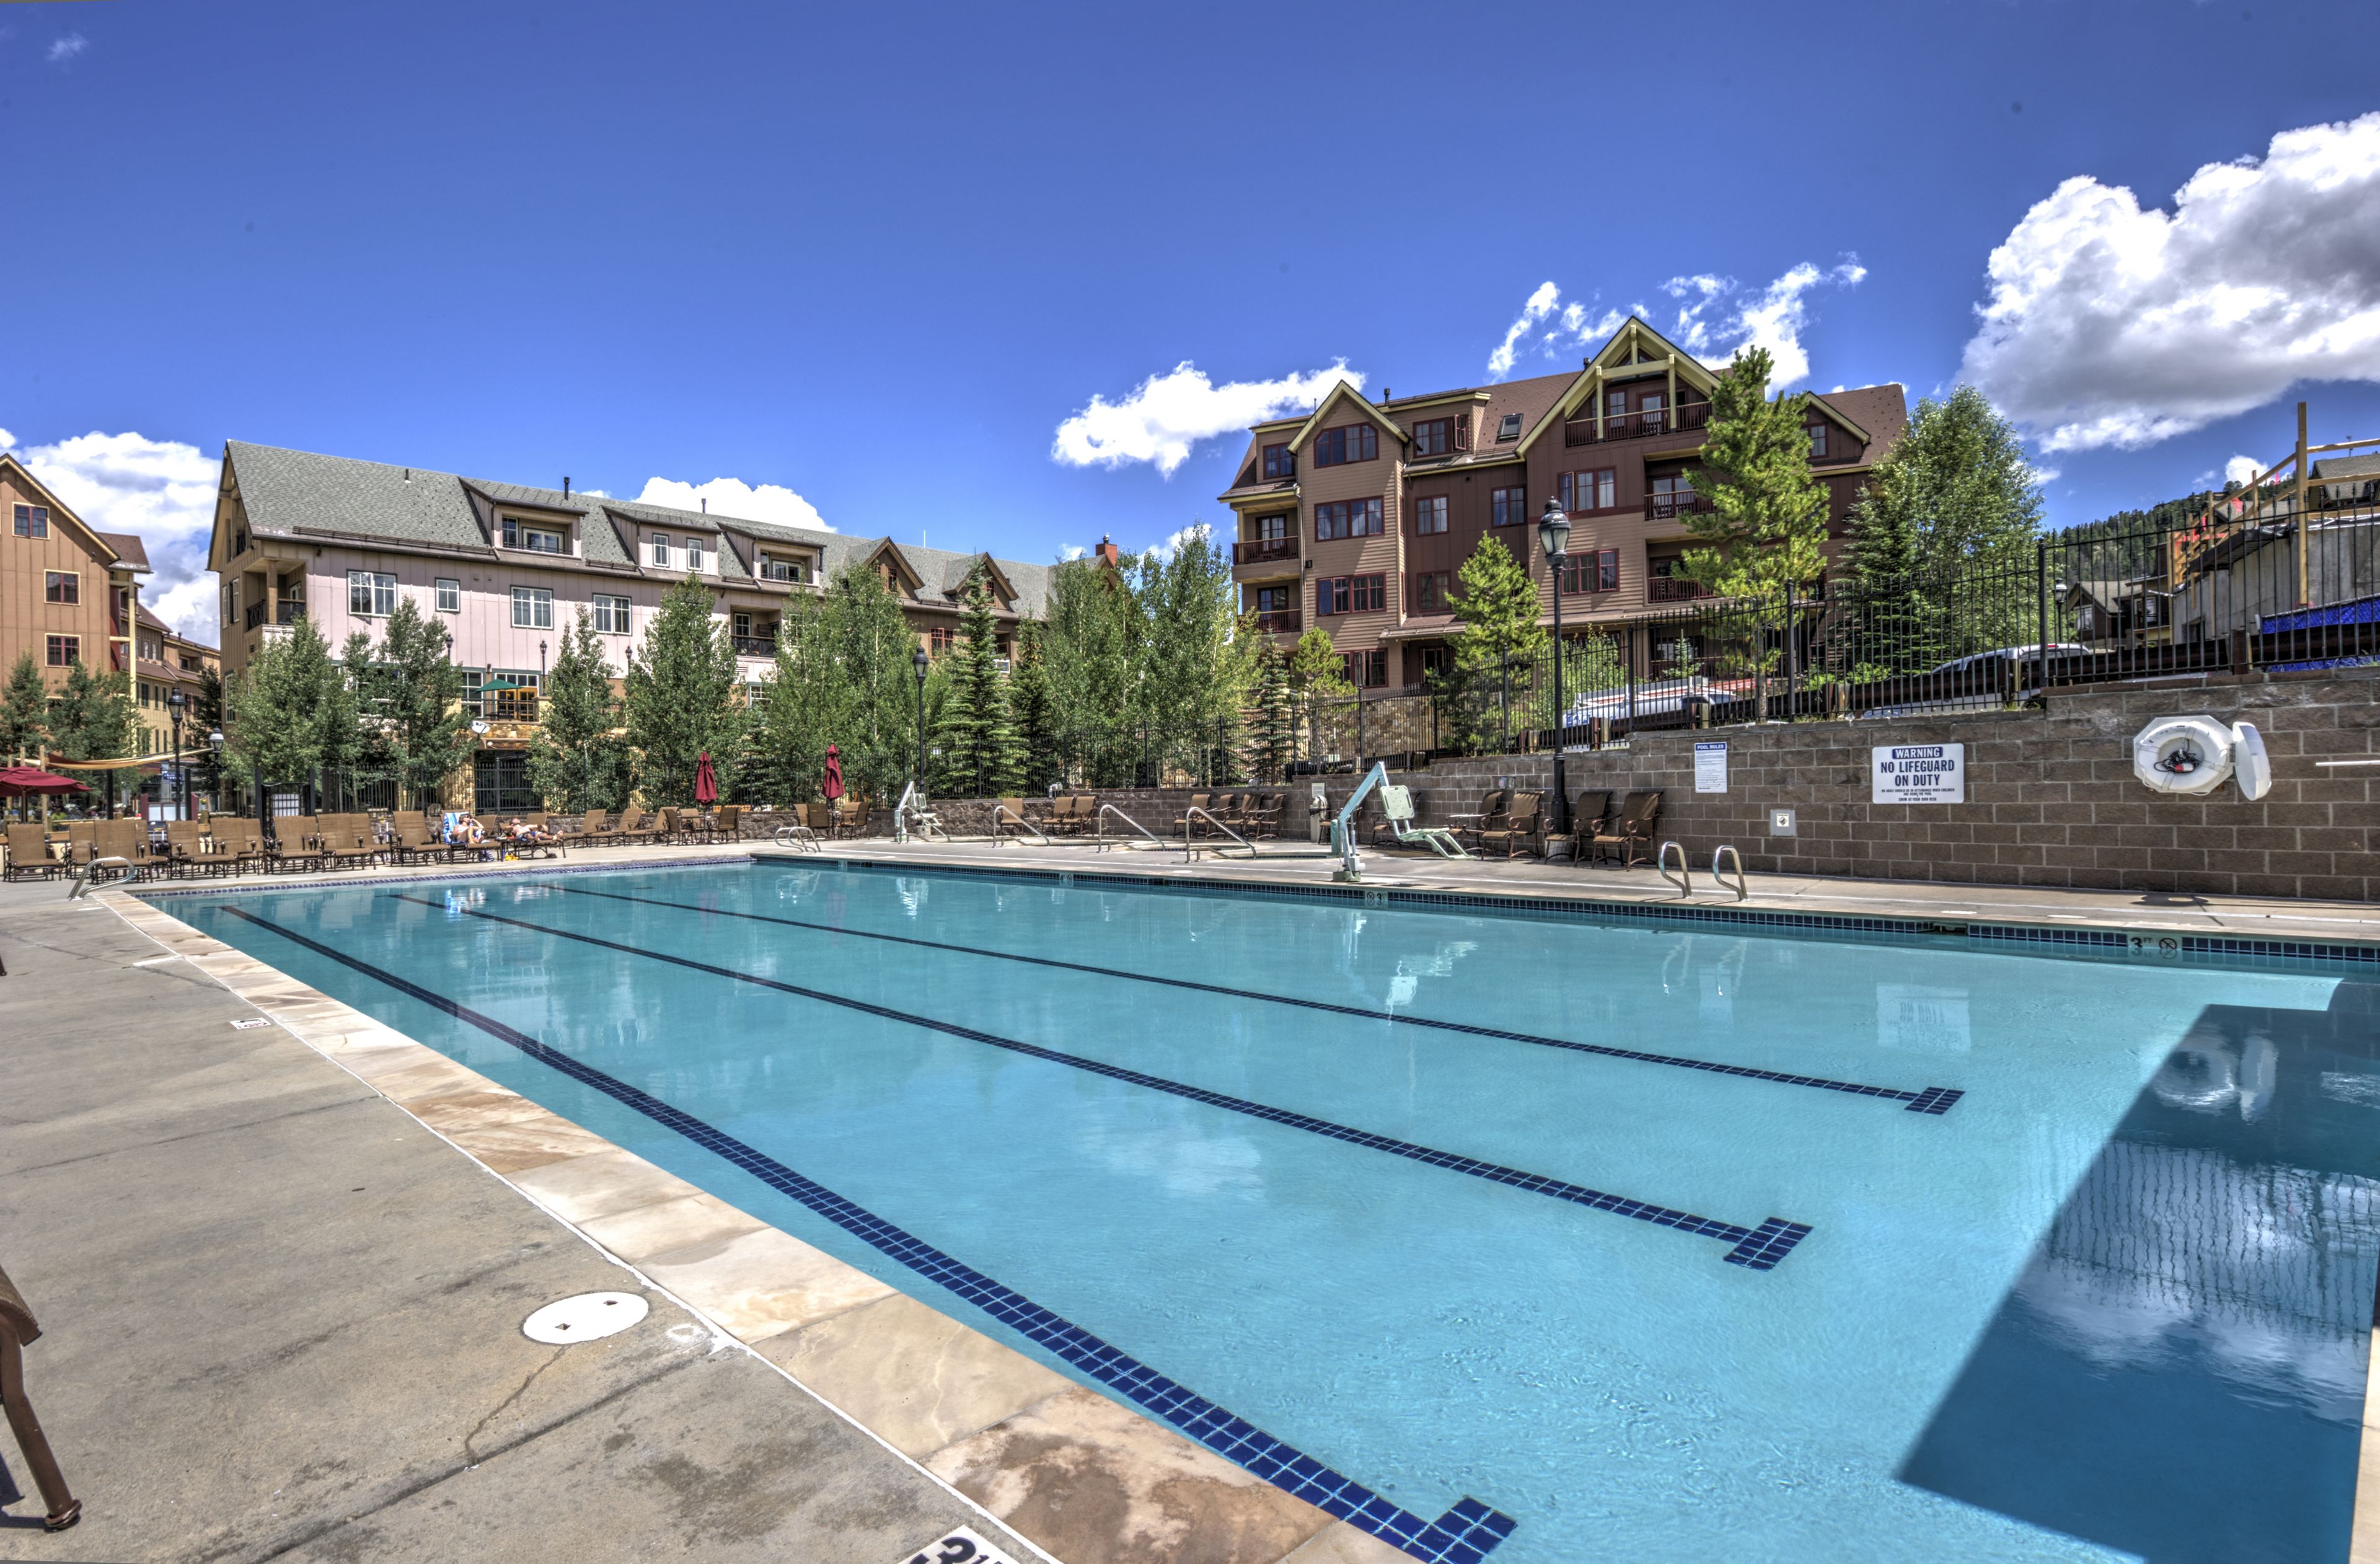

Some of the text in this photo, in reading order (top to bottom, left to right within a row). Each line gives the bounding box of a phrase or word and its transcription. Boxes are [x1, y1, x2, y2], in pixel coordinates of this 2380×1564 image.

[1895, 748, 1940, 758] WARNING
[1880, 760, 1955, 773] NO LIFEGUARD
[1895, 774, 1941, 787] ON DUTY
[2130, 937, 2143, 948] 3
